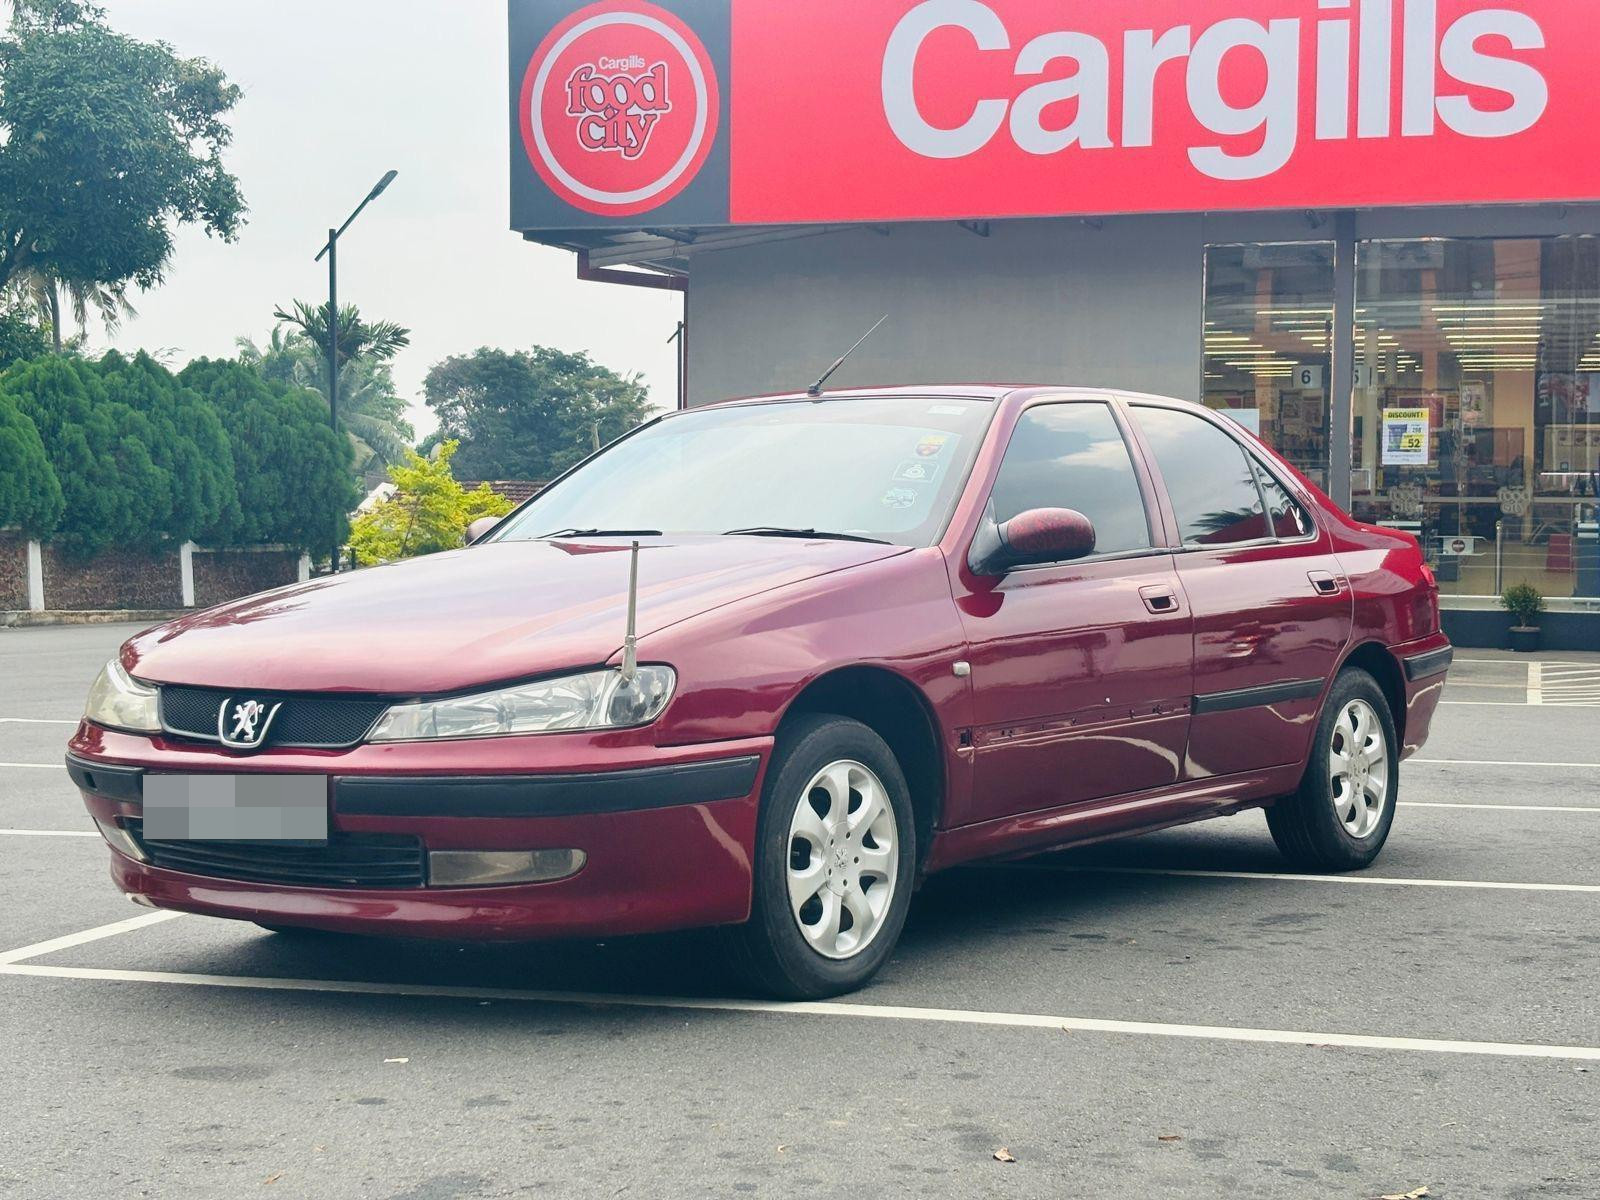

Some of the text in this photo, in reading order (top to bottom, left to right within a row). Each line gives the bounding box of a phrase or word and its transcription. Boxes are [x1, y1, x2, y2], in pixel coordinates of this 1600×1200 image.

[598, 55, 646, 71] Cargills
[567, 62, 671, 115] food
[881, 0, 1548, 180] Cargills
[579, 106, 657, 158] city
[1301, 369, 1311, 385] 6
[1387, 411, 1424, 419] DISCOUNT!
[1408, 438, 1421, 448] 52
